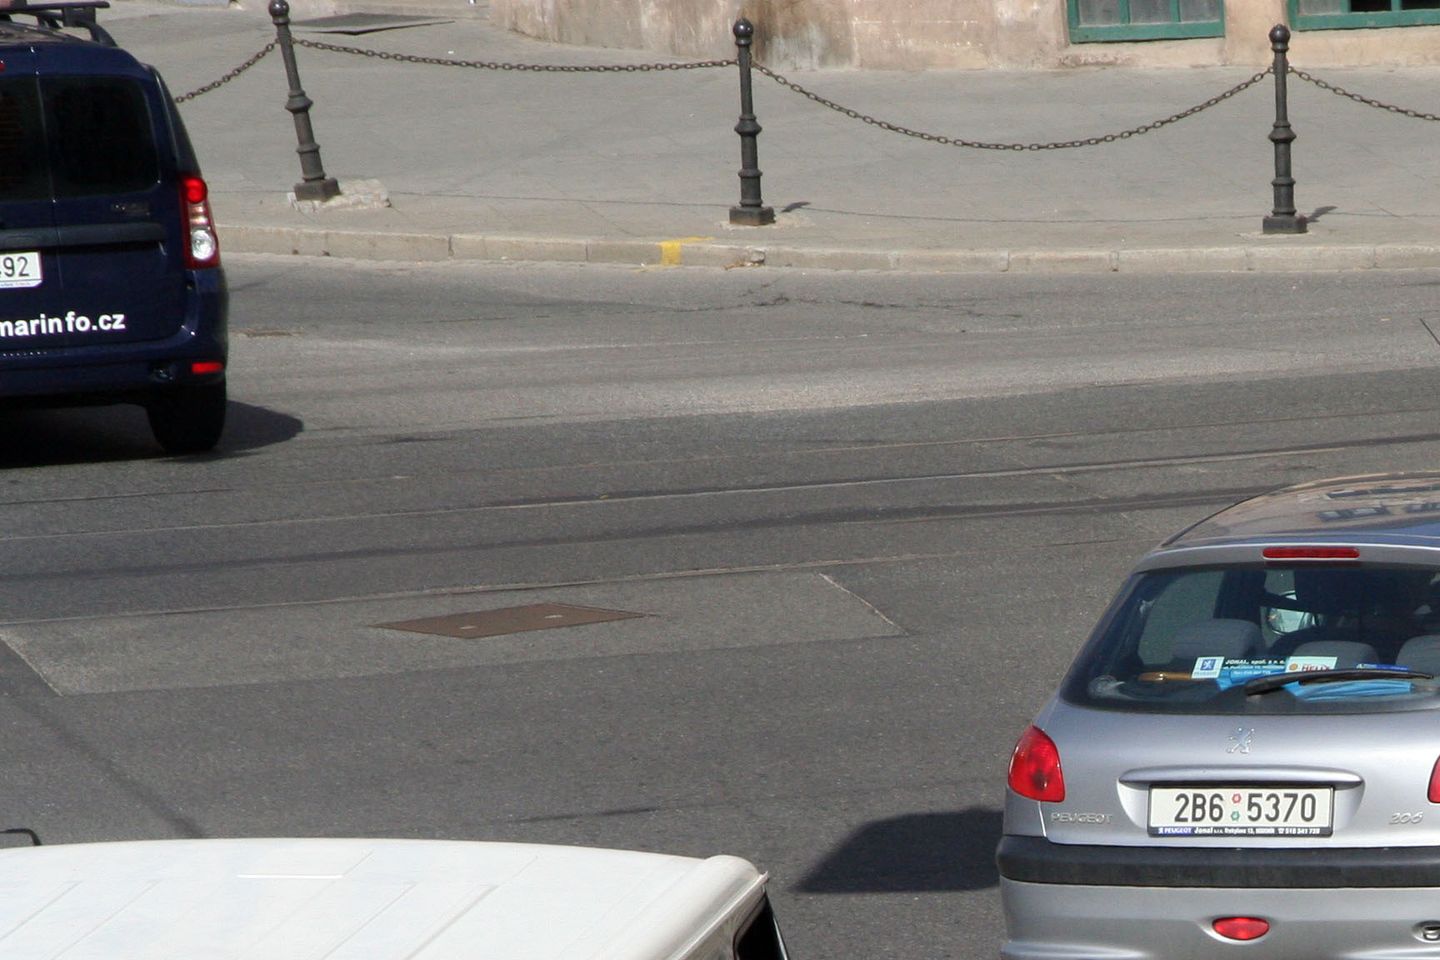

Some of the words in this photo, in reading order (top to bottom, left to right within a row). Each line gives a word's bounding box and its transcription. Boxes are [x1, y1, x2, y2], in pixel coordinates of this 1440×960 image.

[0, 255, 30, 278] 92
[1174, 793, 1224, 822] 2B6
[1247, 793, 1316, 822] 5370
